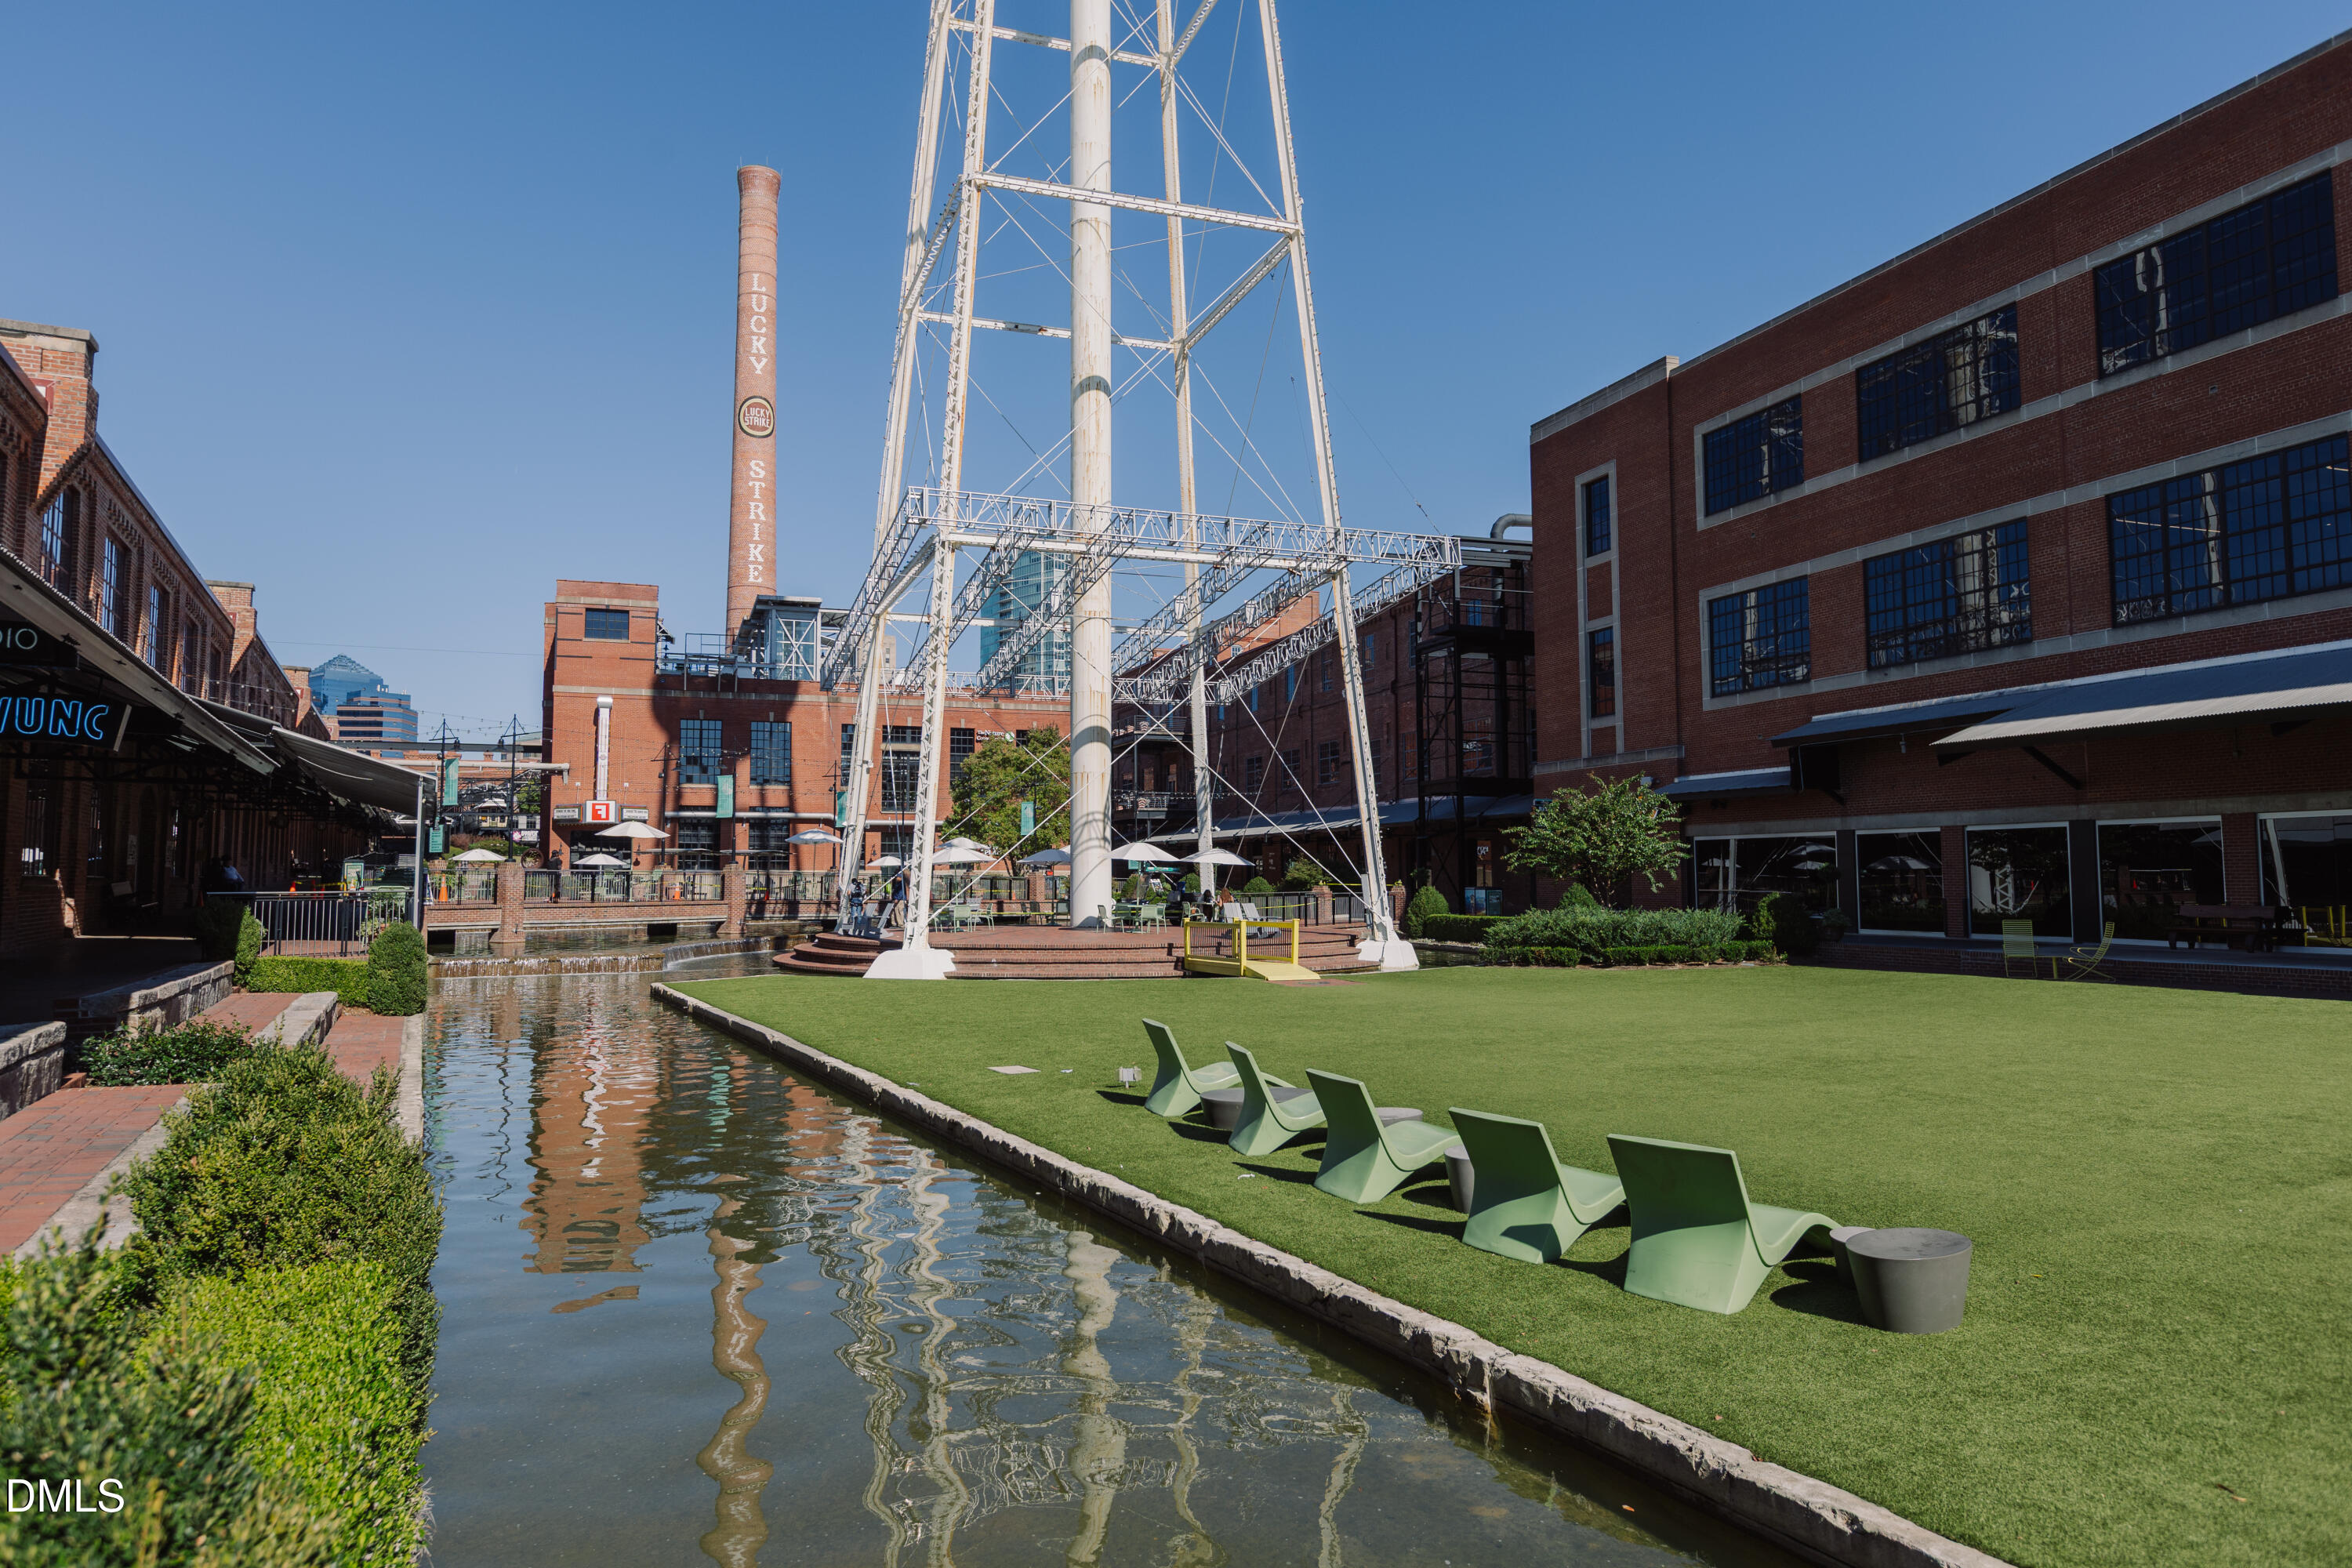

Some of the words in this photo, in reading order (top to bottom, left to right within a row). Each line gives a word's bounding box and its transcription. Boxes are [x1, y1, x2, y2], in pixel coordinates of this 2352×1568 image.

[750, 274, 768, 374] LUCKY
[745, 407, 770, 418] LUCKY
[745, 416, 770, 428] STRIKE
[748, 459, 766, 583] STRIKE
[0, 628, 38, 650] IO
